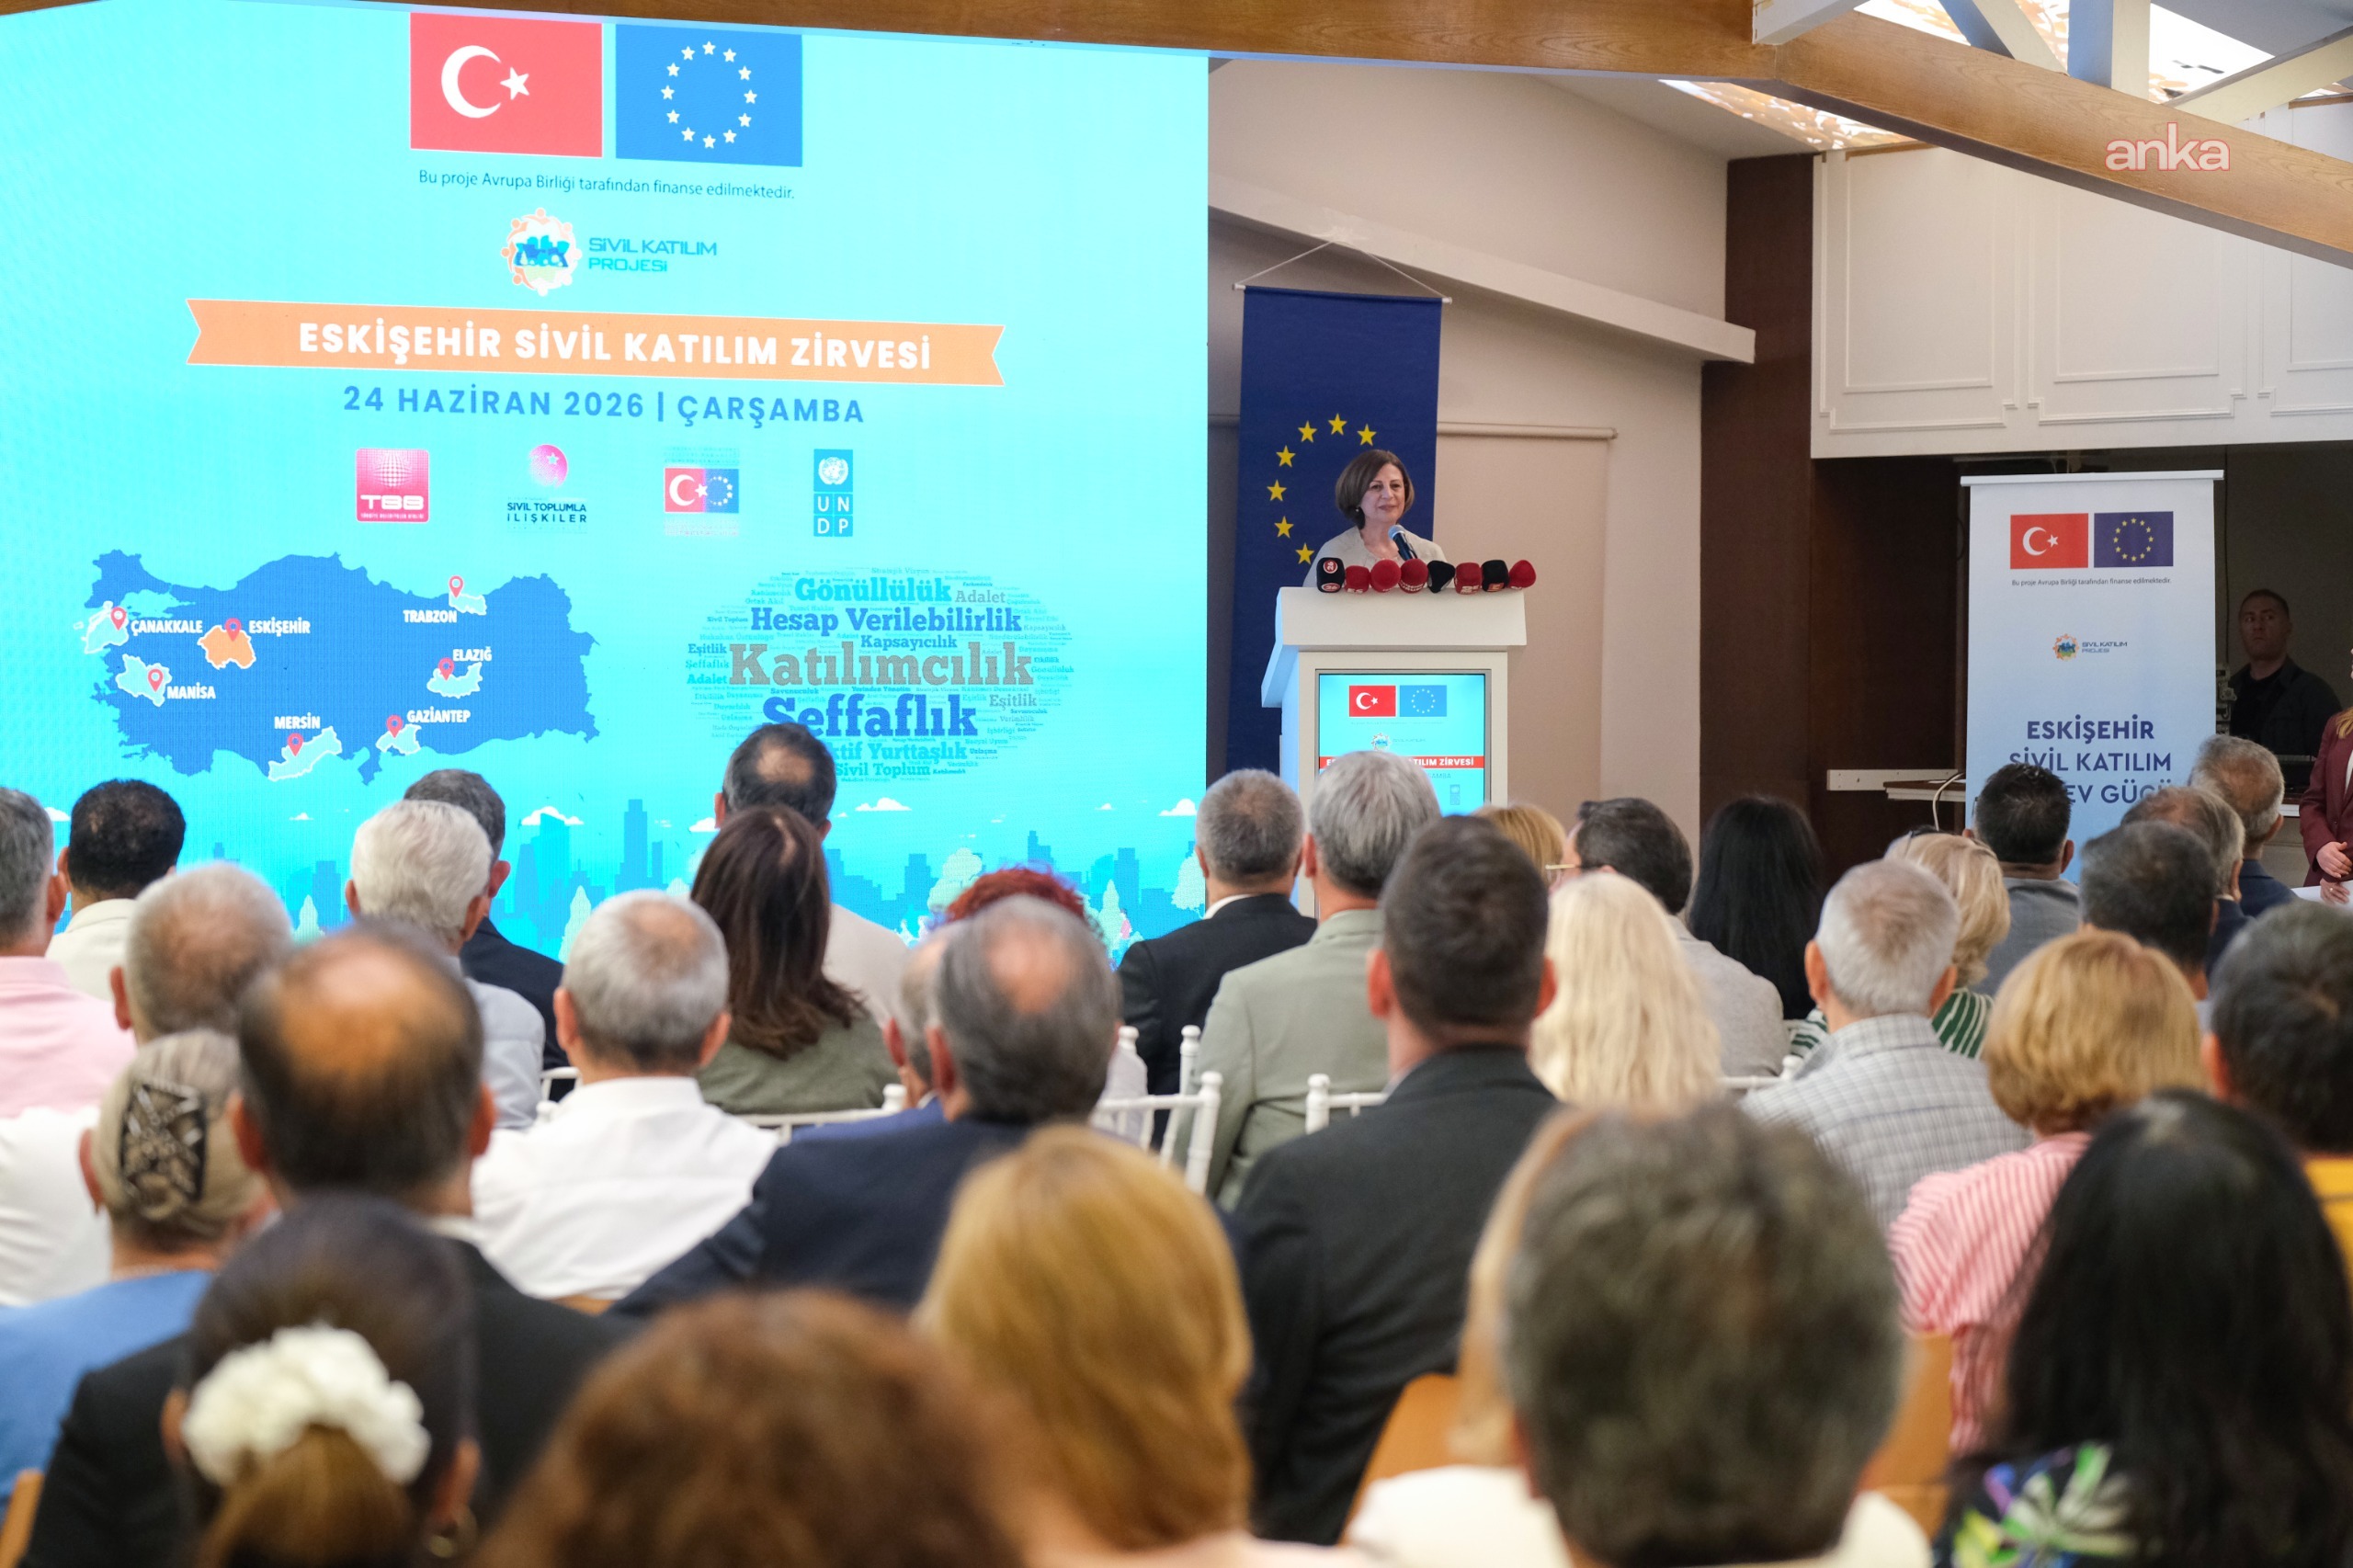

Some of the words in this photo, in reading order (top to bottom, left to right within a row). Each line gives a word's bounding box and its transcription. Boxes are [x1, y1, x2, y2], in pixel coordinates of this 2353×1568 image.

[419, 170, 438, 183] Bu
[441, 172, 478, 188] proje
[483, 173, 532, 190] Avrupa
[535, 175, 575, 193] Birliği
[579, 177, 650, 193] tarafından
[654, 179, 703, 195] finanse
[707, 182, 795, 199] edilmektedir.
[642, 240, 718, 256] KATILIM
[300, 317, 501, 365] ESKİŞEHİR
[515, 323, 611, 361] SİVİL
[624, 332, 777, 366] KATILIM
[790, 331, 930, 369] ZİRVESİ
[344, 385, 383, 412] 24
[398, 383, 551, 415] HAZİRAN
[564, 392, 643, 418] 2026
[677, 394, 864, 428] ÇARŞAMBA
[360, 494, 424, 510] TBB
[507, 502, 531, 511] SİVİL
[533, 502, 587, 512] TOPLUMLA
[795, 577, 952, 602] Gönüllülük
[955, 590, 1006, 603] Adalet
[403, 609, 457, 623] TRABZON
[751, 607, 838, 636] Hesap
[846, 607, 1022, 631] Verilebilirlik
[131, 619, 202, 636] ÇANAKKALE
[249, 617, 311, 637] ESKİŞEHİR
[688, 643, 727, 656] Eşitlik
[861, 634, 958, 651] Kapsayıcılık
[453, 646, 492, 661] ELAZIĞ
[730, 642, 1033, 686] Katılımcılık
[687, 673, 727, 685] Adalet
[167, 682, 216, 699] MANİSA
[989, 694, 1037, 710] Eşitlik
[274, 711, 321, 729] MERSİN
[407, 706, 471, 723] GAZİANTEP
[2028, 714, 2154, 744] ESKİŞEHİR
[867, 741, 967, 764] Yurttaşlık
[873, 762, 930, 778] Toplum
[1439, 757, 1474, 766] ZİRVESİ
[2076, 752, 2171, 771] KATILIM
